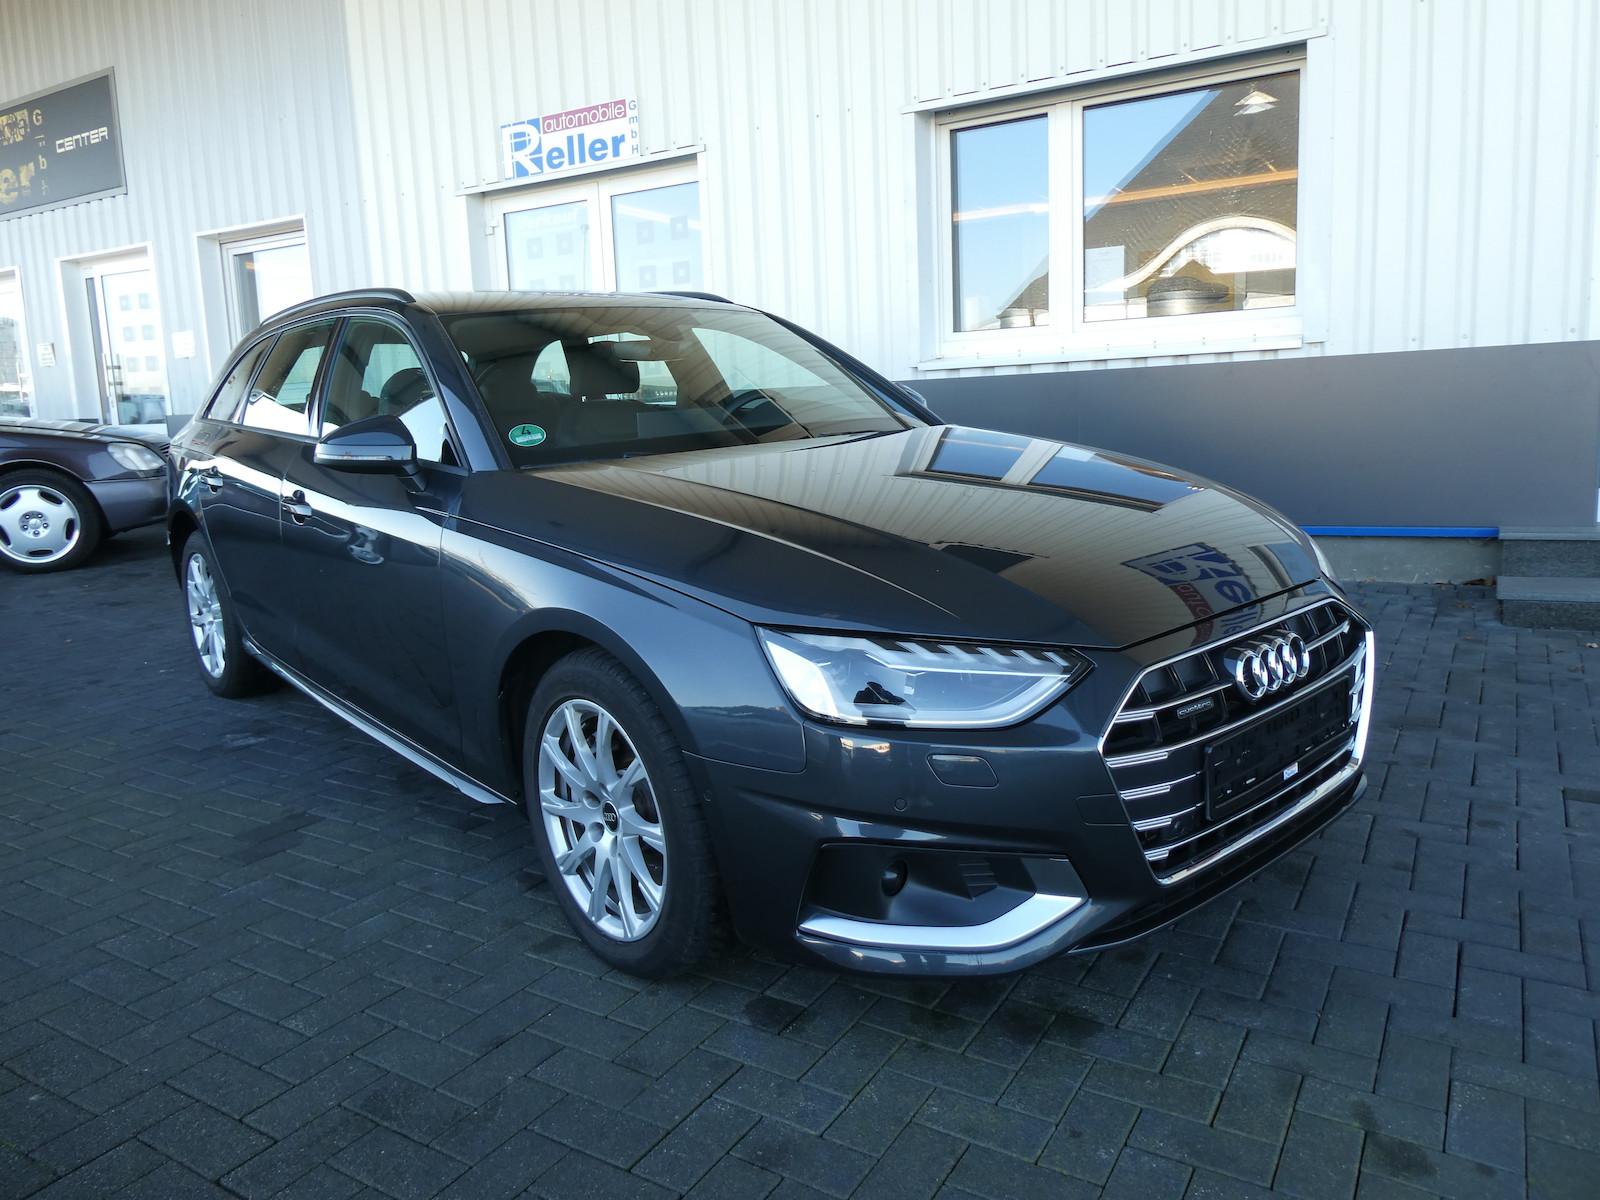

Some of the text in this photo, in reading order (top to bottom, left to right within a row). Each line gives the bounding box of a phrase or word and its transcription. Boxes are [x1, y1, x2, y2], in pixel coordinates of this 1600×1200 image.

[543, 102, 626, 133] automobile
[55, 126, 108, 153] CENTER
[501, 118, 626, 180] Reller
[521, 425, 532, 435] 4
